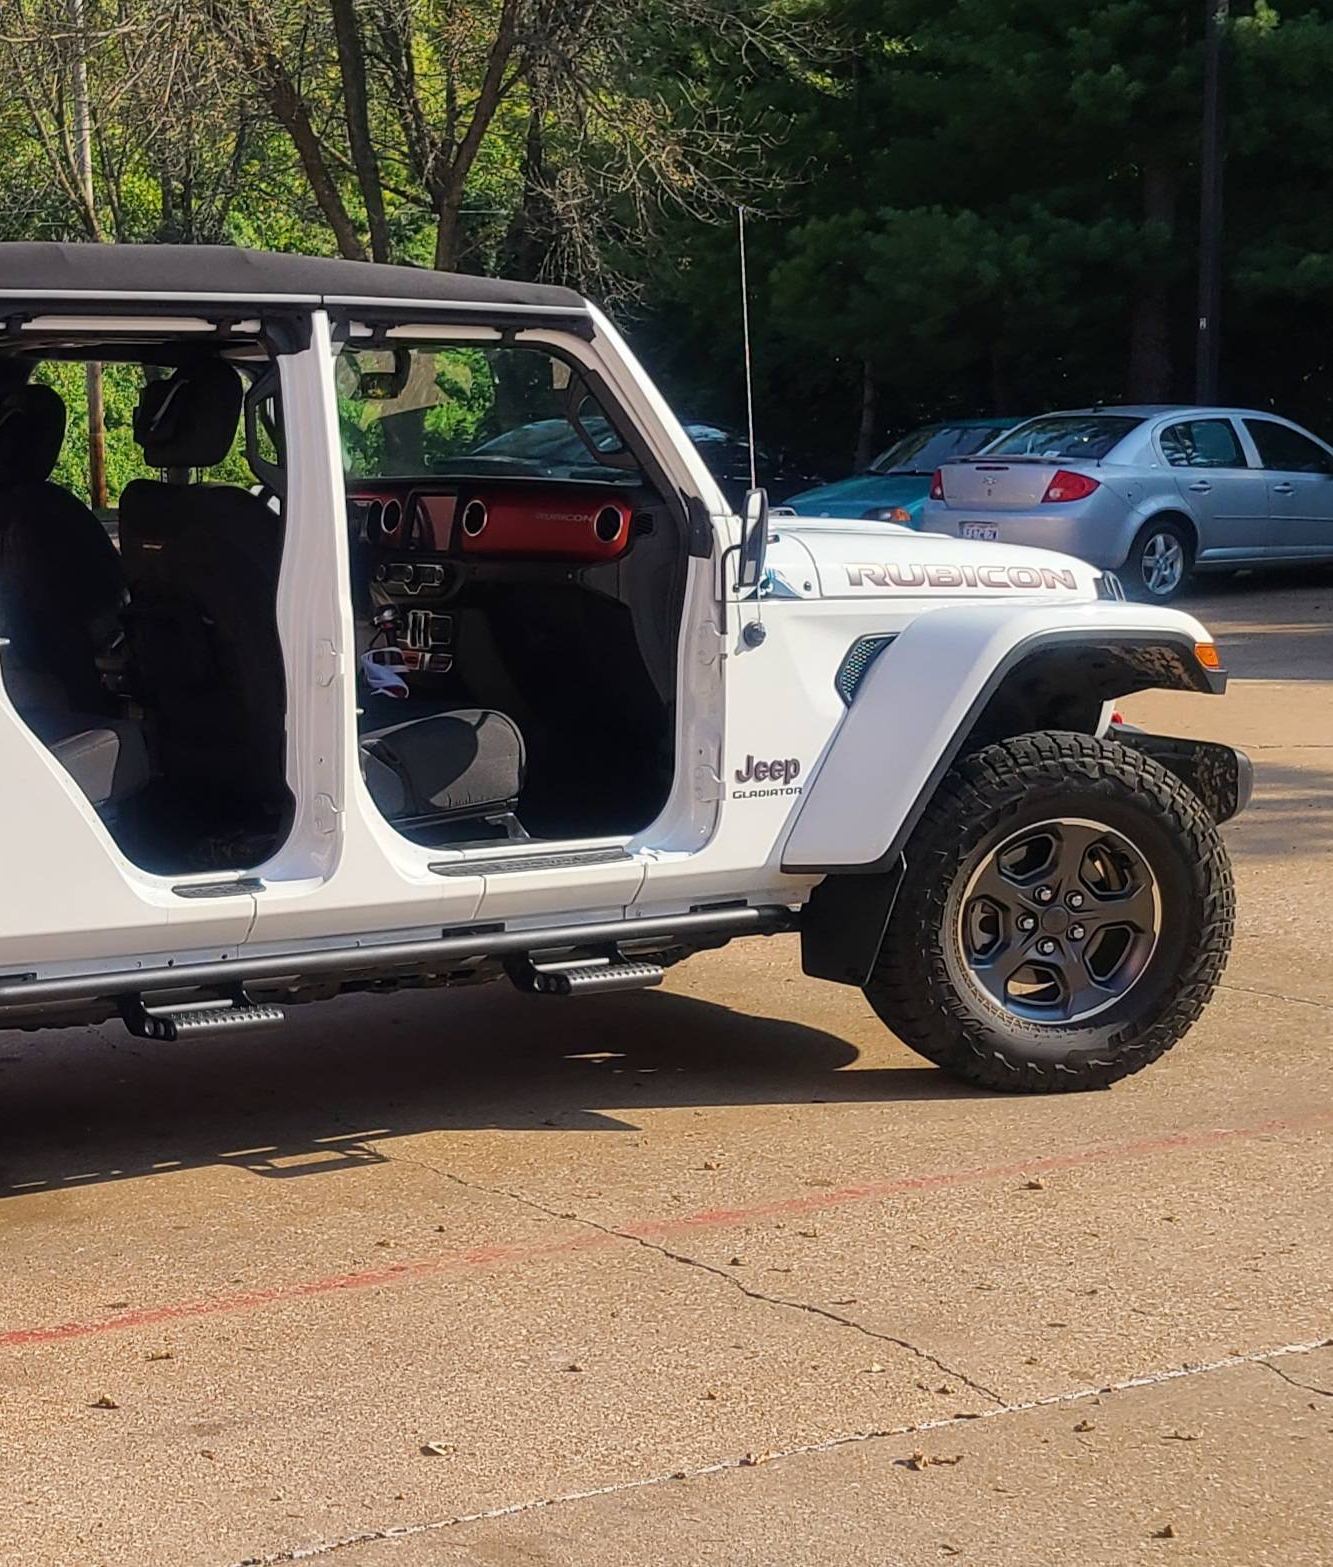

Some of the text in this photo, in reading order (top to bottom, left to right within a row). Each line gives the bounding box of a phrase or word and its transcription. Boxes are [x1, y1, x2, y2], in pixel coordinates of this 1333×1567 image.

[842, 562, 1078, 590] RUBICON
[734, 754, 800, 785] Jeep
[732, 787, 804, 800] GLADIATOR
